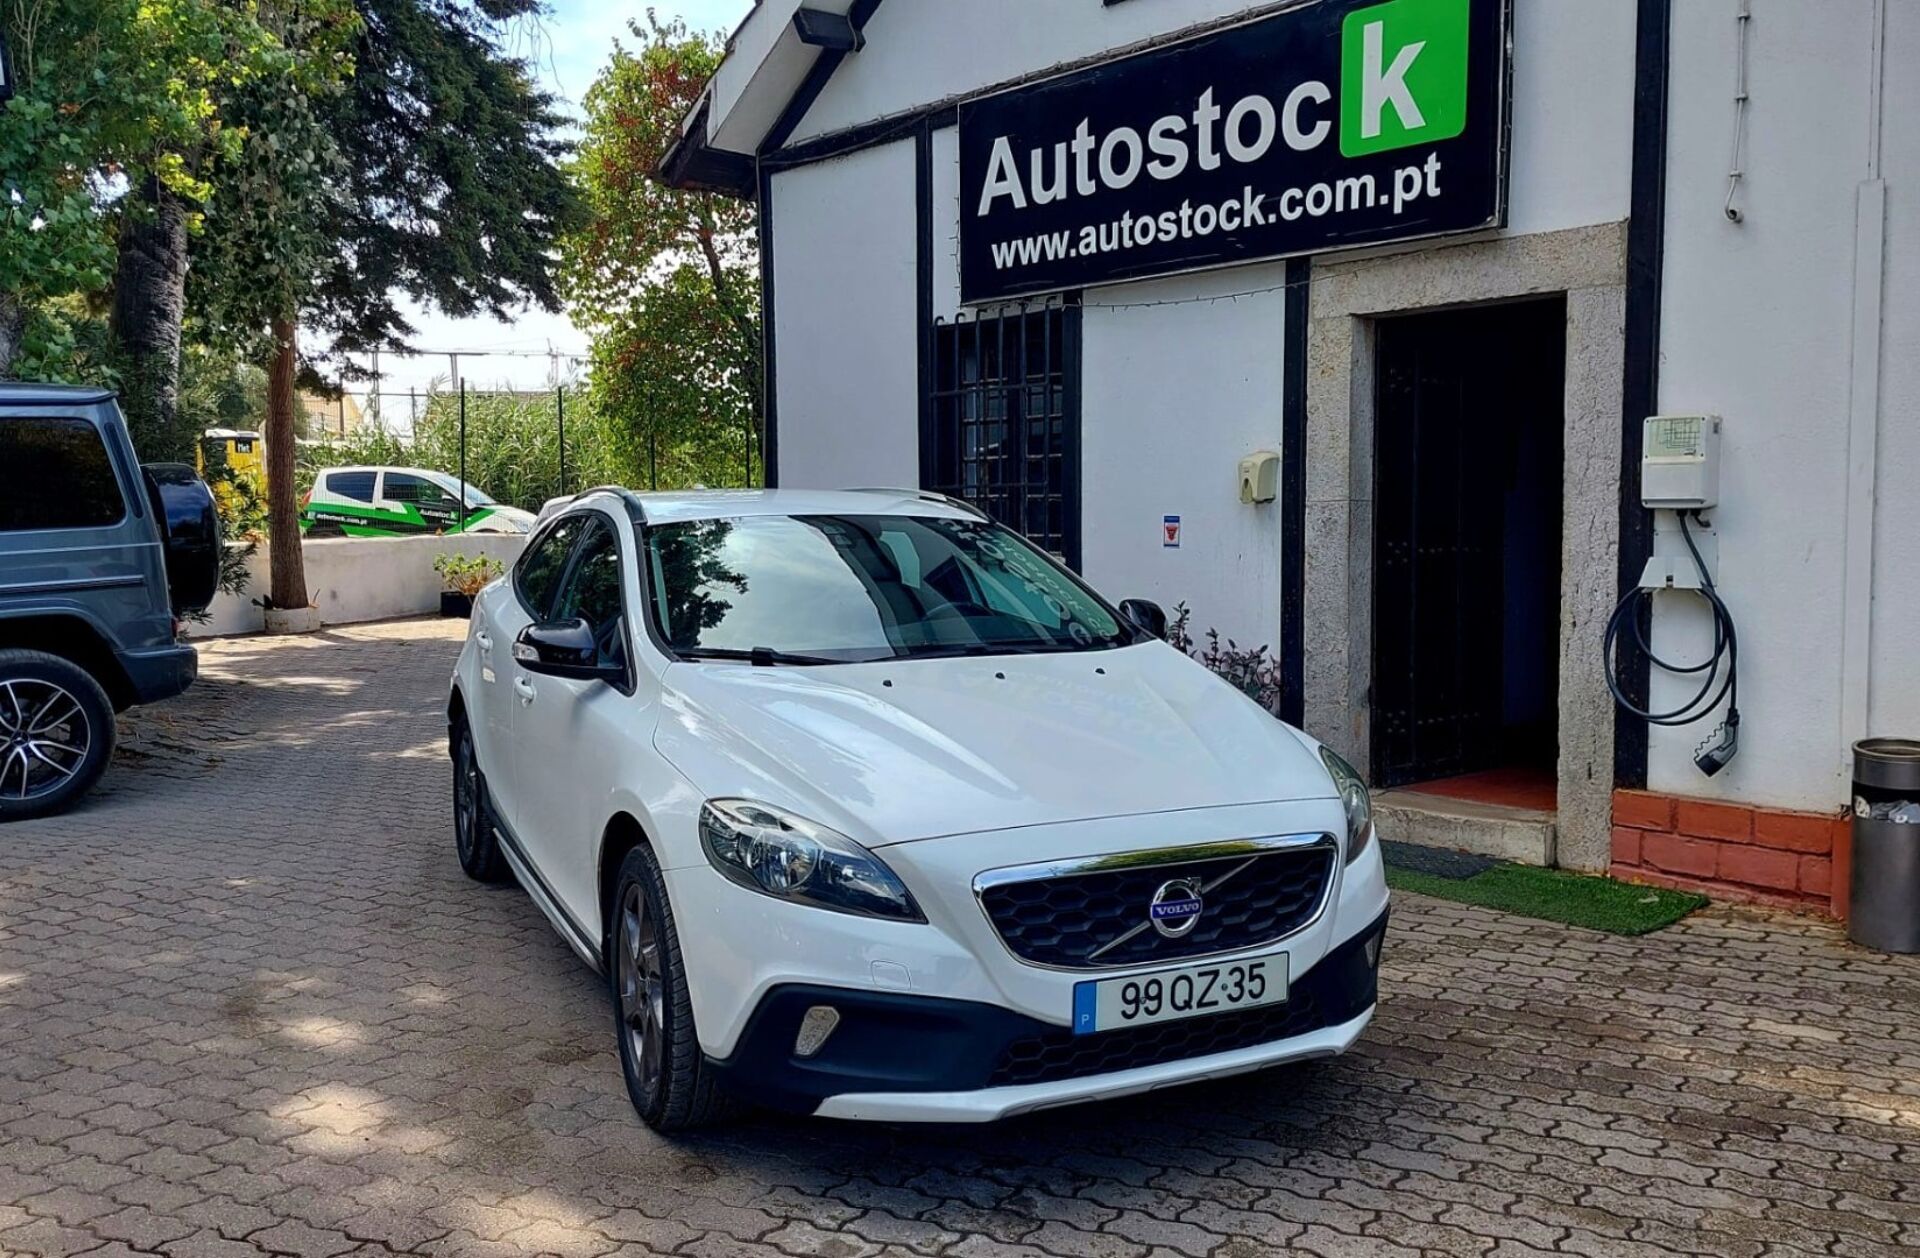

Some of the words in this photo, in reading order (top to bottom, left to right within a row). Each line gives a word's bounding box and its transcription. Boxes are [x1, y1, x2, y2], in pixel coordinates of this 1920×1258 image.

[977, 20, 1427, 217] Autostock
[991, 152, 1442, 270] www.autostock.com.pt
[1155, 902, 1200, 916] VOLVO
[1081, 1014, 1090, 1025] P
